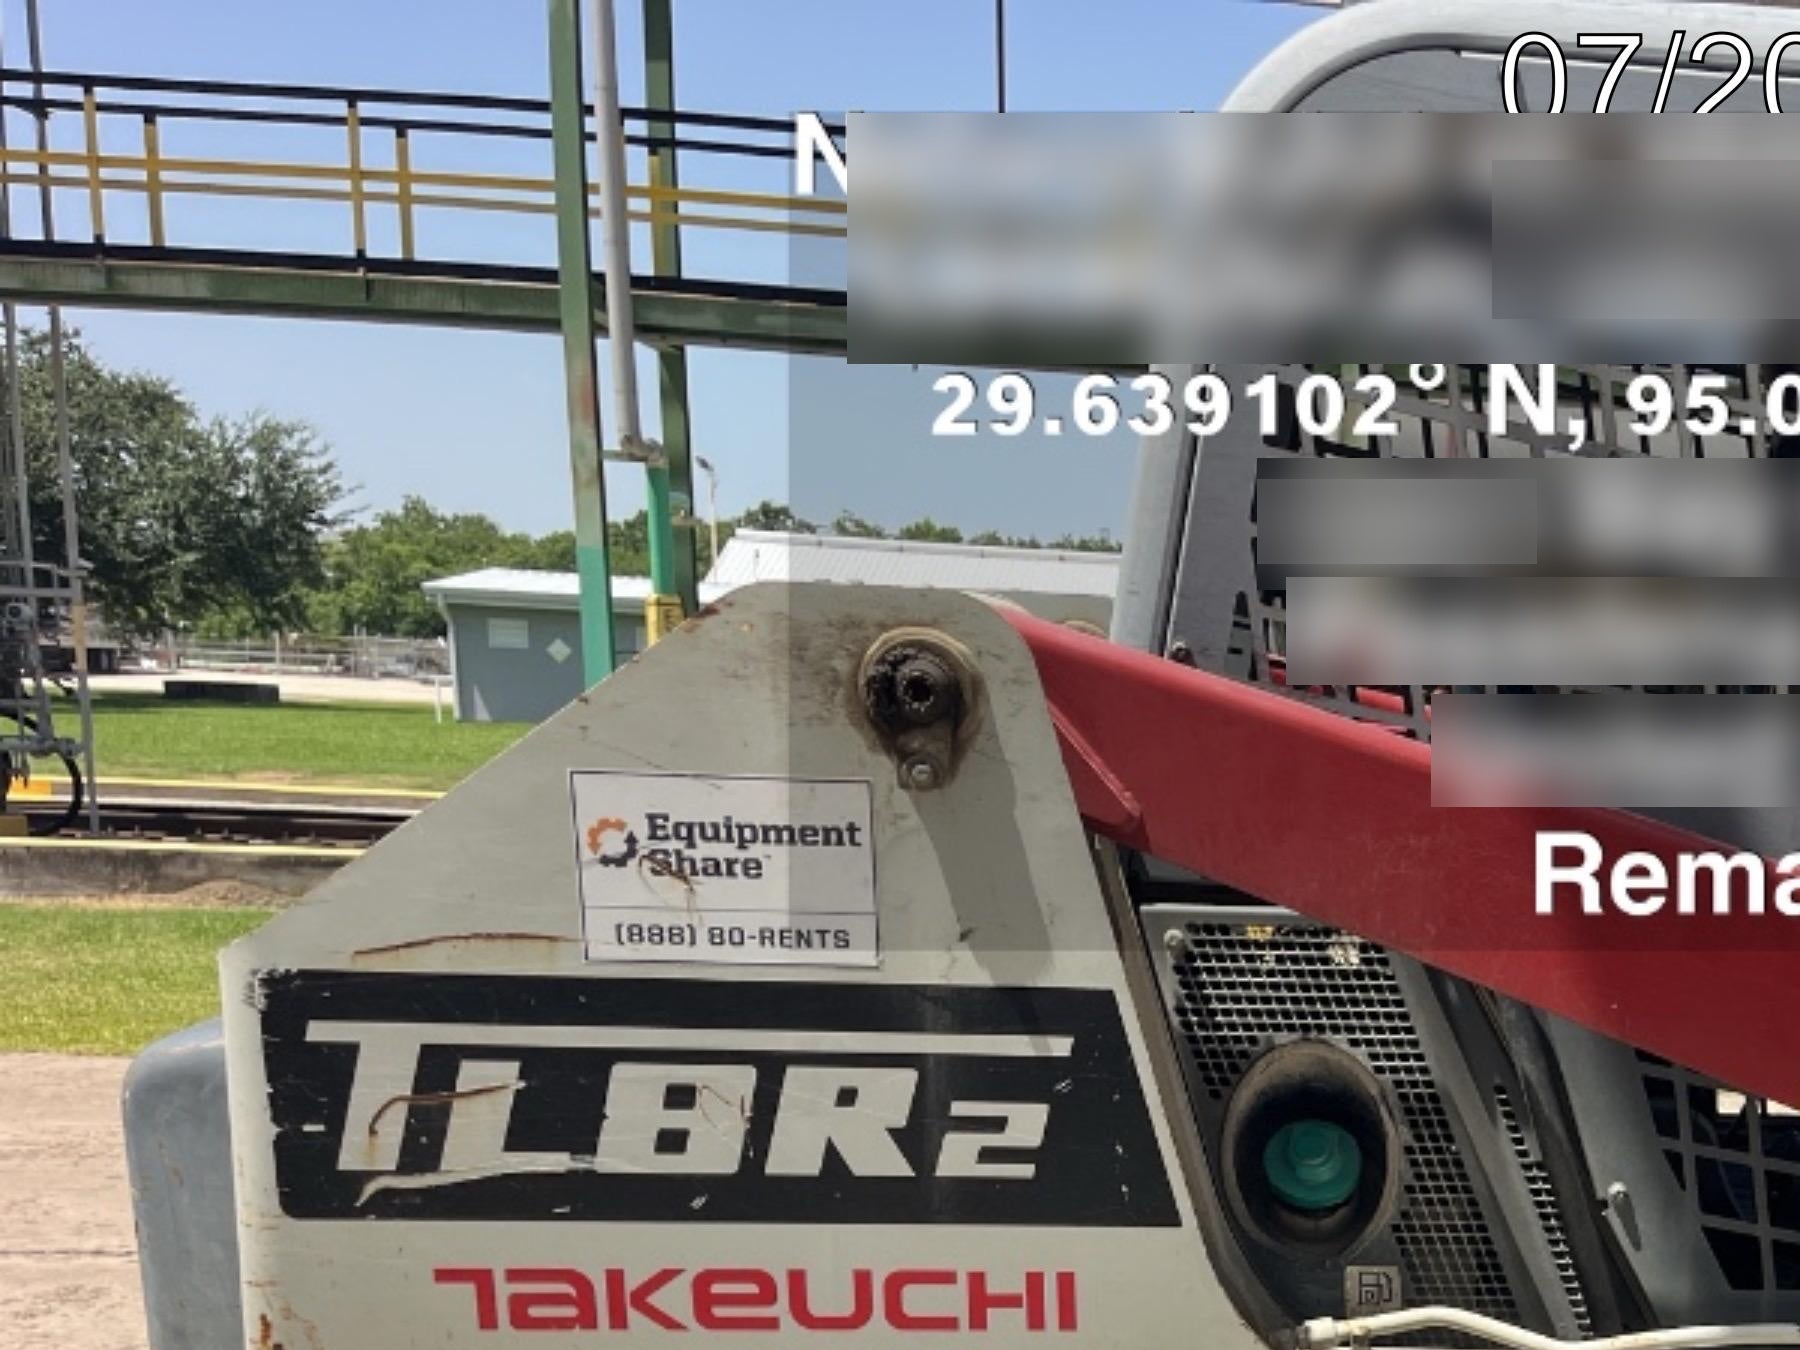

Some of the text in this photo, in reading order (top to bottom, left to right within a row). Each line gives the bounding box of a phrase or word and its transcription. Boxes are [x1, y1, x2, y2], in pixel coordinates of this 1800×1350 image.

[645, 812, 862, 849] Equipment
[648, 848, 764, 880] Share
[614, 922, 851, 950] (888) 80-RENTS
[304, 1019, 1075, 1181] TL8R2
